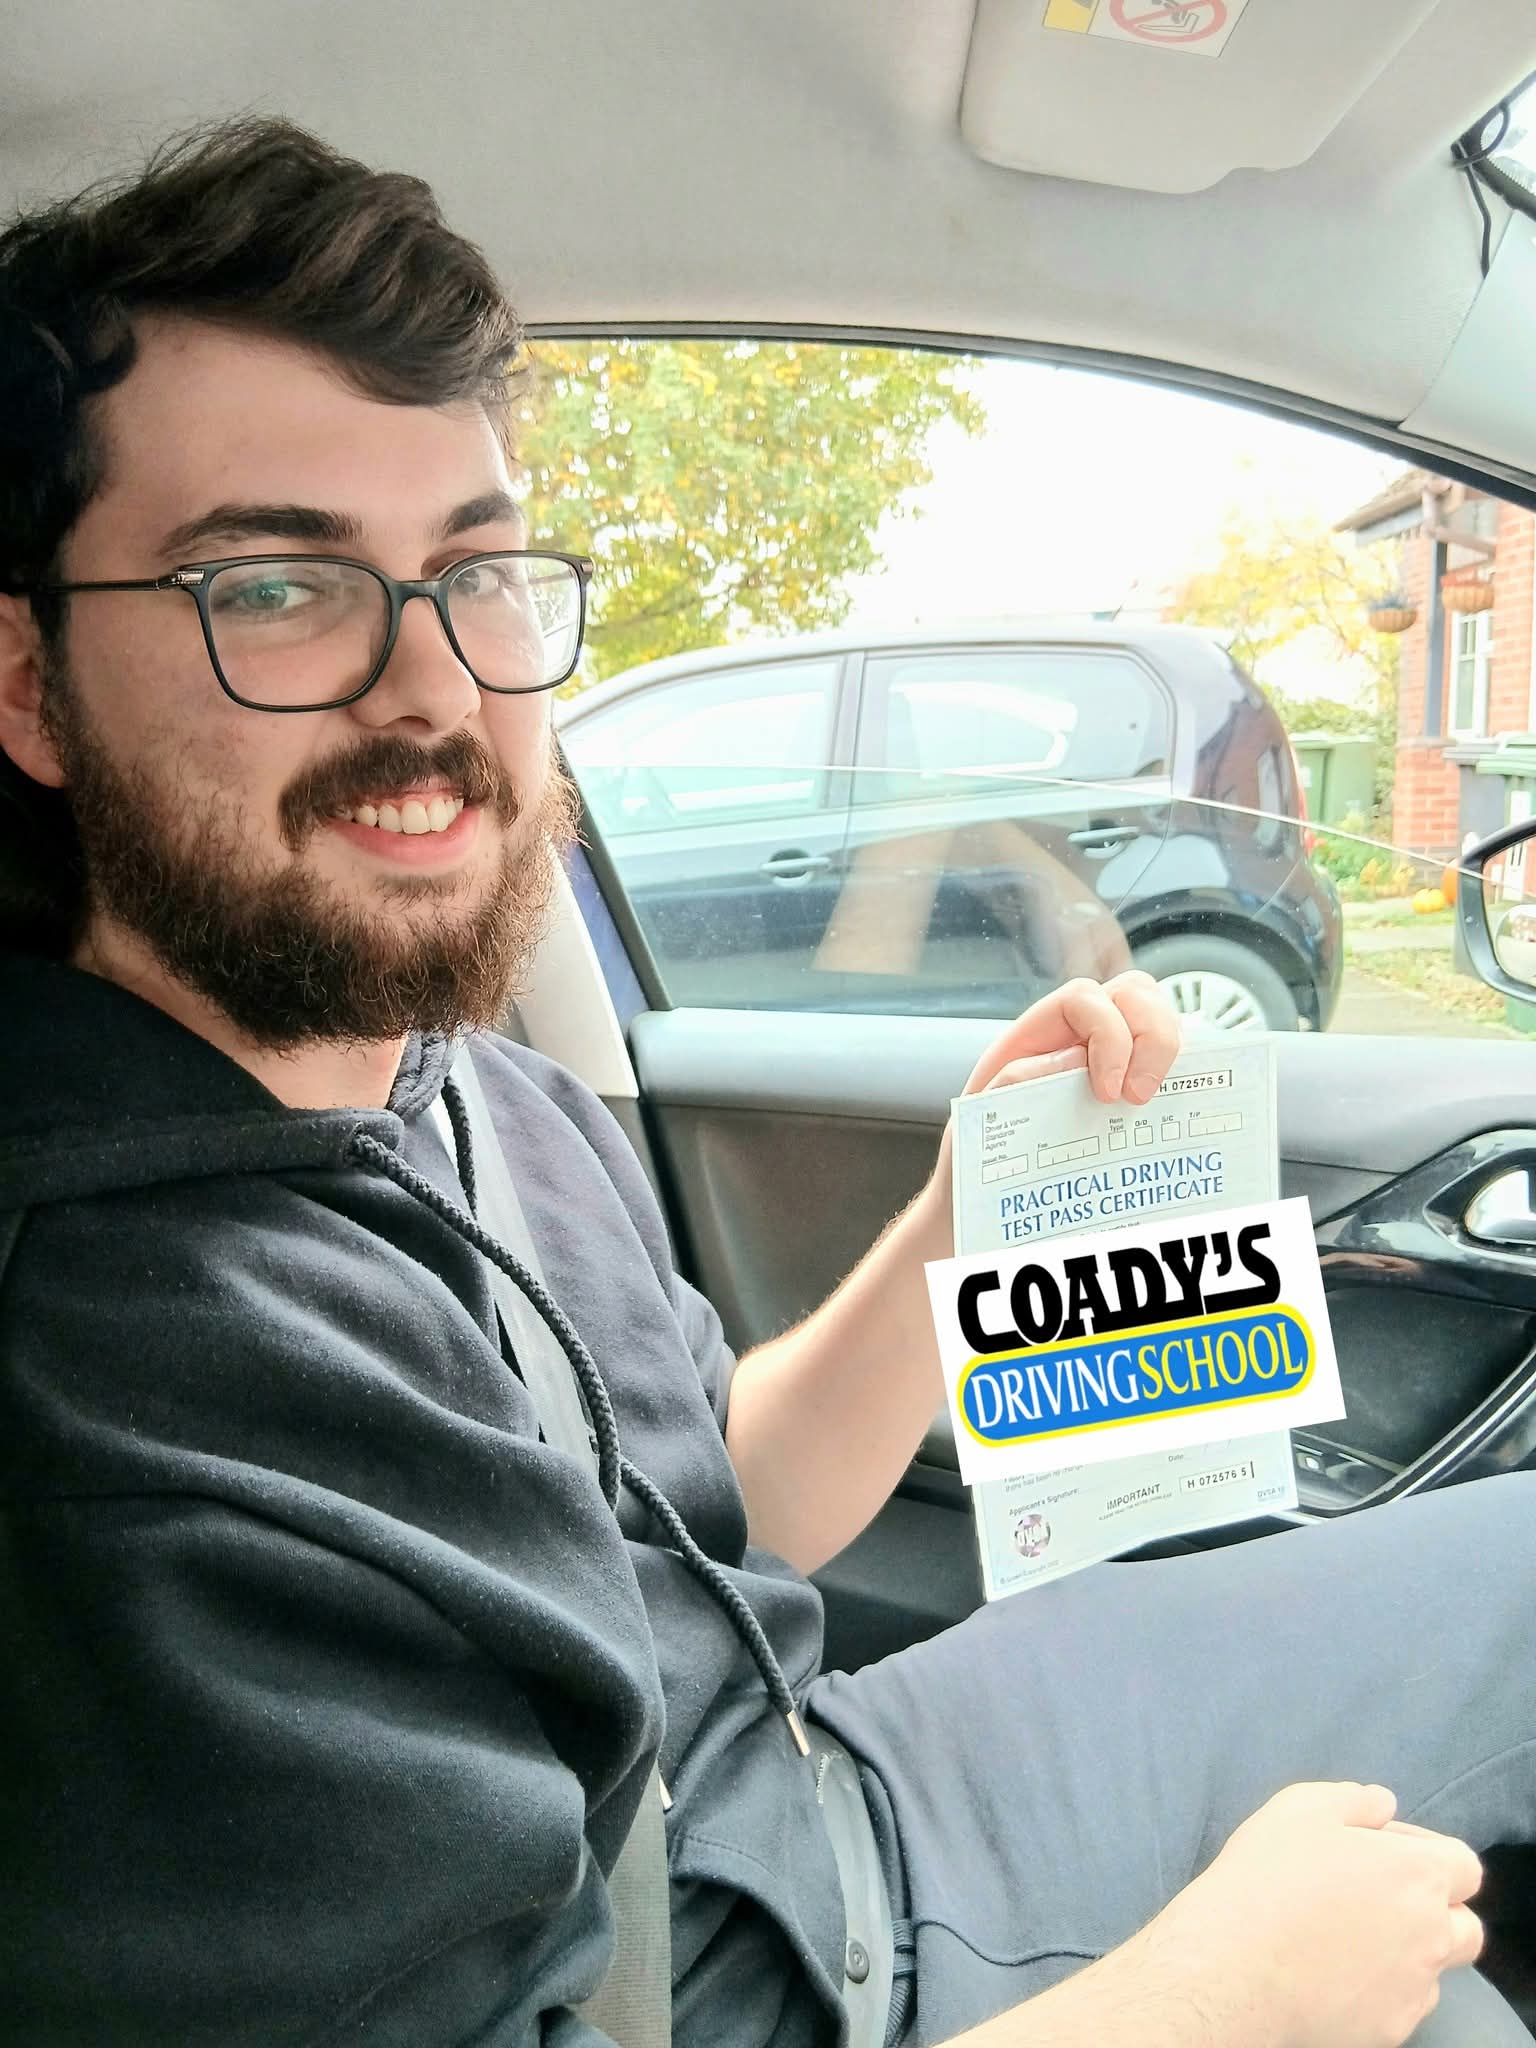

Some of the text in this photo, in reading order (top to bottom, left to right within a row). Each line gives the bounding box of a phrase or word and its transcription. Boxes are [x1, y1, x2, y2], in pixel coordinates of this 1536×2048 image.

[1159, 1075, 1224, 1092] H 072576 5
[1000, 1151, 1223, 1218] PRACTICAL DRIVING
[1001, 1175, 1224, 1241] TEST PASS CERTIFICATE
[1187, 1467, 1247, 1489] H 072576 5
[1106, 1483, 1161, 1511] IMPORTANT
